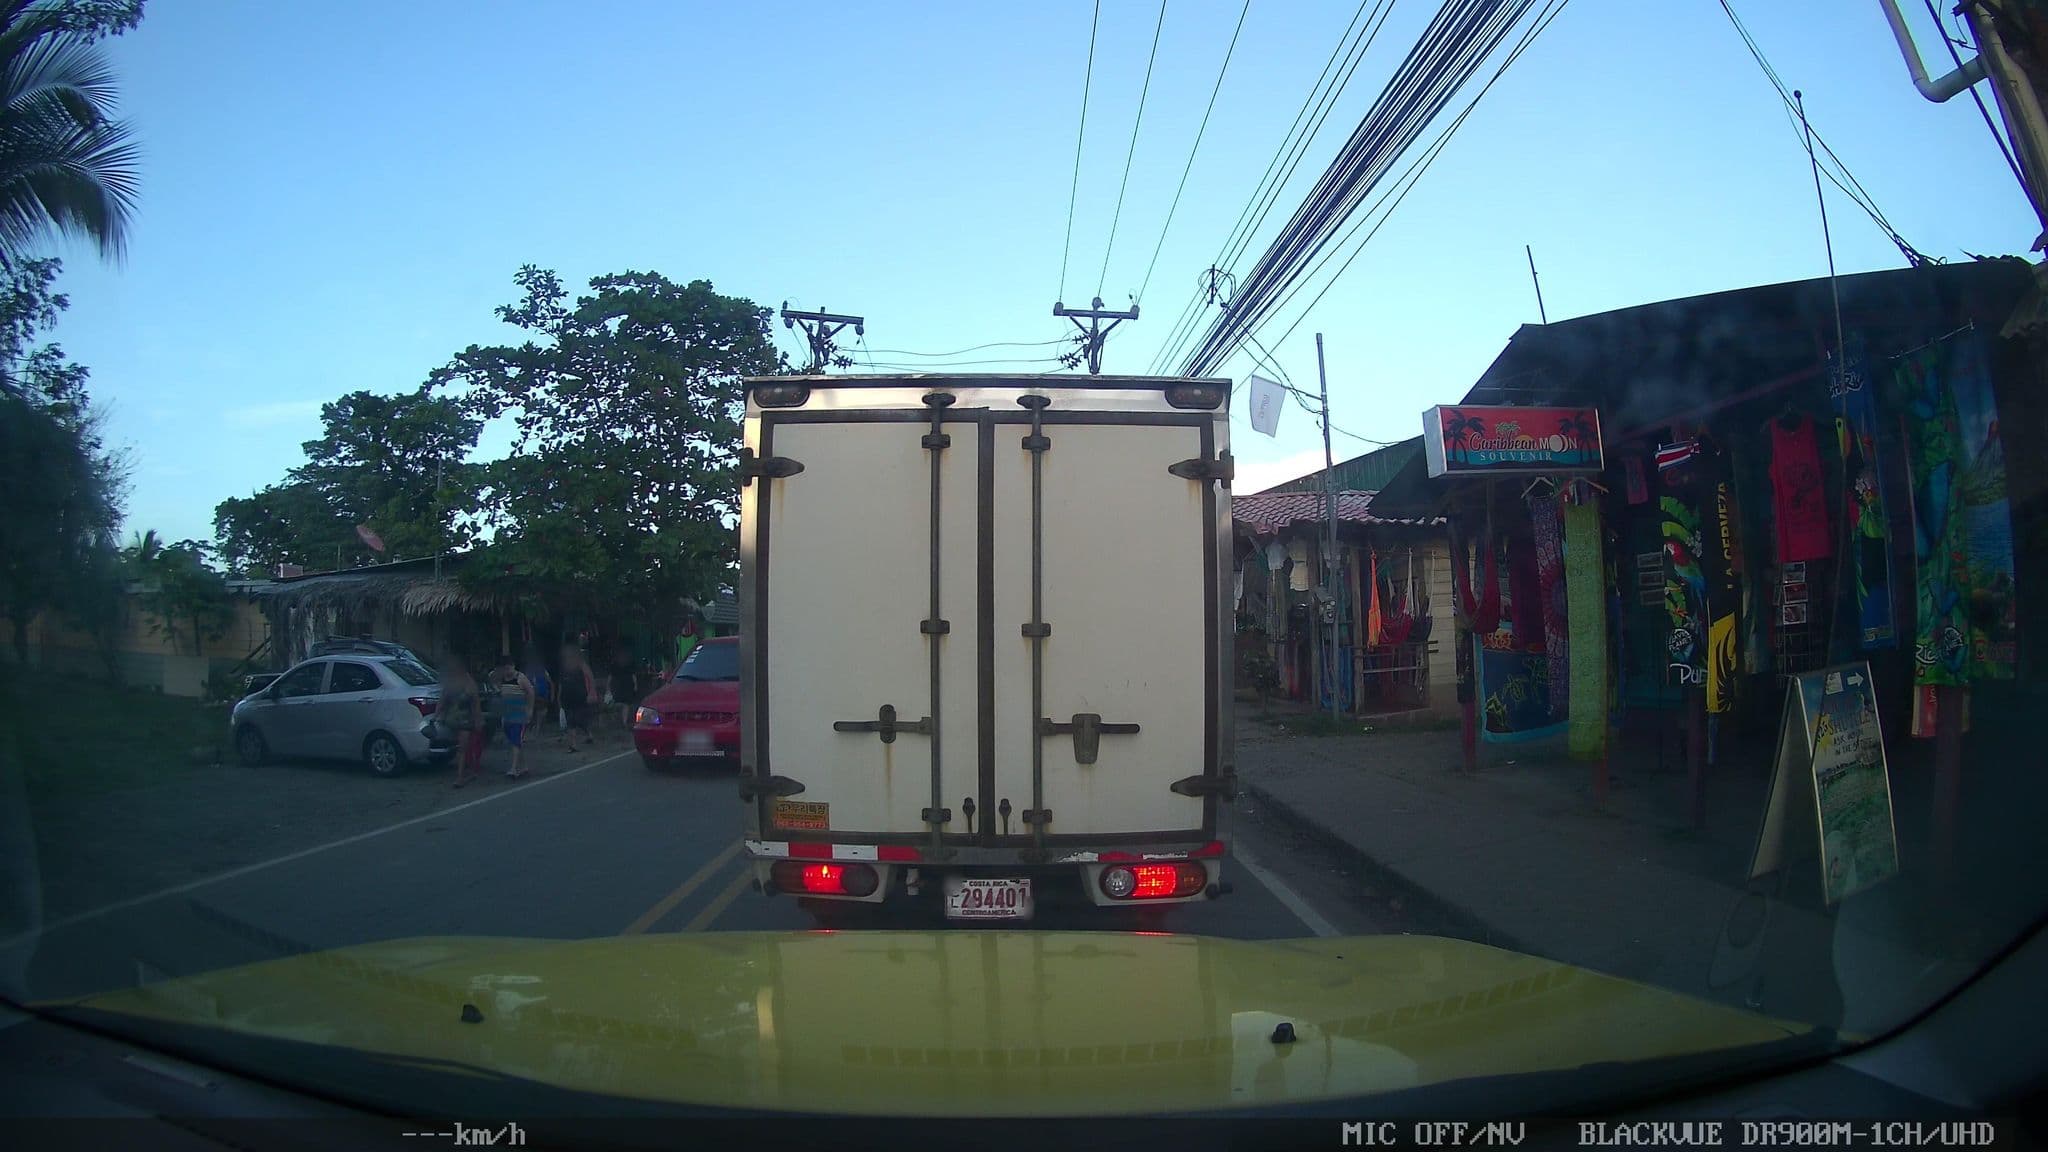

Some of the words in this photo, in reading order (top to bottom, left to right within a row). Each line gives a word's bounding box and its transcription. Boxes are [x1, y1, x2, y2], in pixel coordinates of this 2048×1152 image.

[1470, 432, 1538, 453] Caribbean
[1479, 451, 1553, 462] SOUVENIR
[961, 888, 1026, 908] 294401
